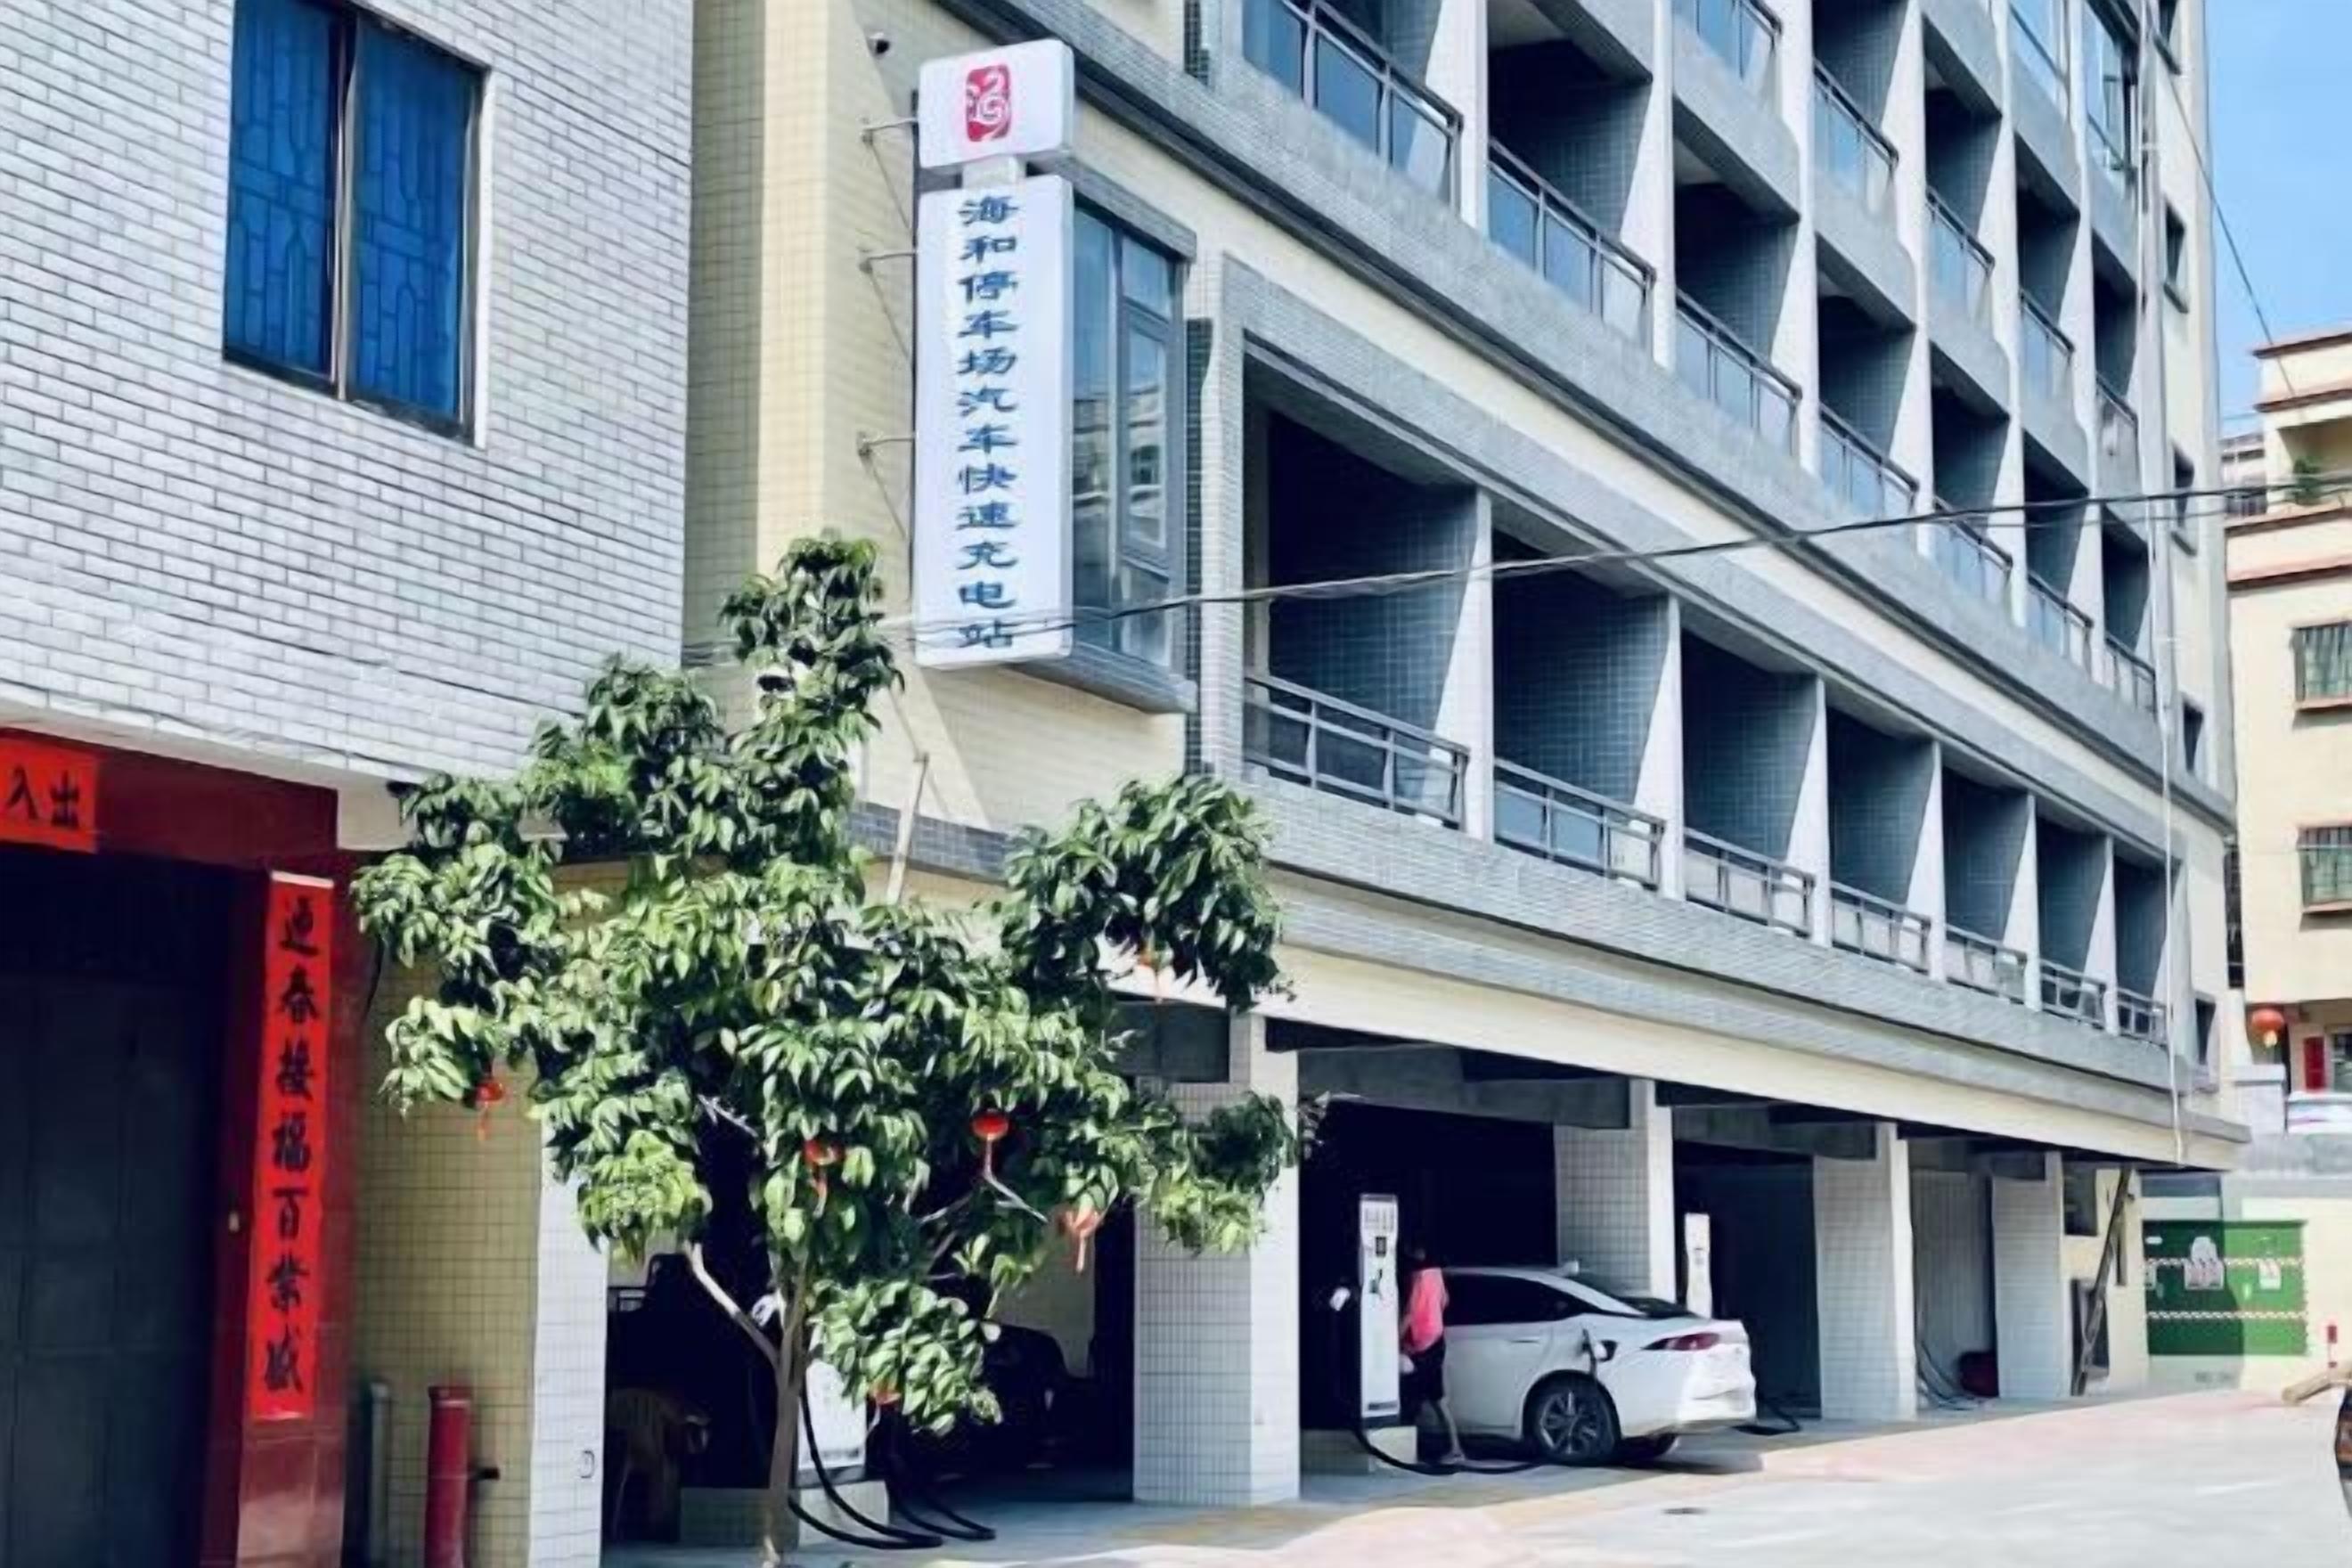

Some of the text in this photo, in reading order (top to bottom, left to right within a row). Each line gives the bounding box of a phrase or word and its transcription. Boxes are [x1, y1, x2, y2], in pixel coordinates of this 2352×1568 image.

[956, 195, 1020, 649] 海和停车场汽车快速充电站
